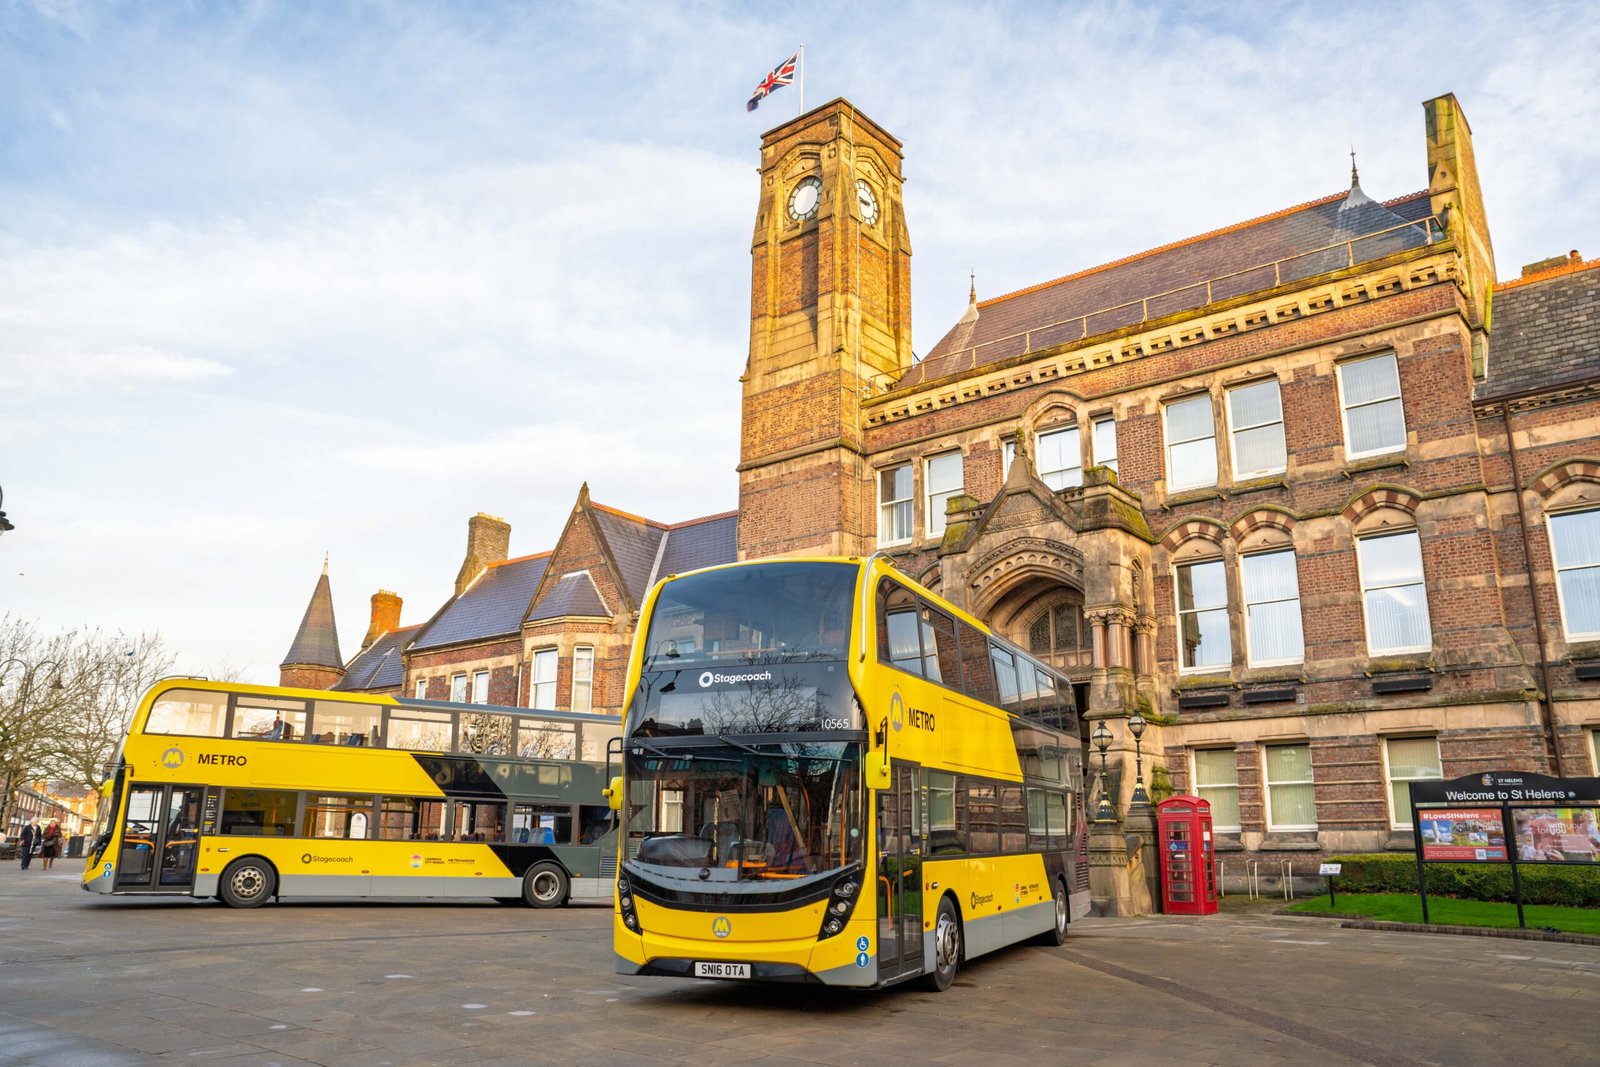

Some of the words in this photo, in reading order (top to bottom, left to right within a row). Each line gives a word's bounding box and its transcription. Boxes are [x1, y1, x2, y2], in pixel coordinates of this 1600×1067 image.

[714, 671, 771, 684] Stagecoach
[821, 718, 849, 729] 10565
[908, 707, 936, 732] METRO
[197, 753, 247, 767] METRO
[1445, 791, 1495, 800] Welcome
[1497, 790, 1509, 800] to
[1511, 789, 1523, 799] St
[1525, 789, 1566, 799] Helens
[1547, 821, 1566, 829] with
[1549, 828, 1567, 836] you
[312, 855, 353, 863] Stagecoach
[701, 964, 722, 975] SN16
[725, 965, 745, 976] OTA
